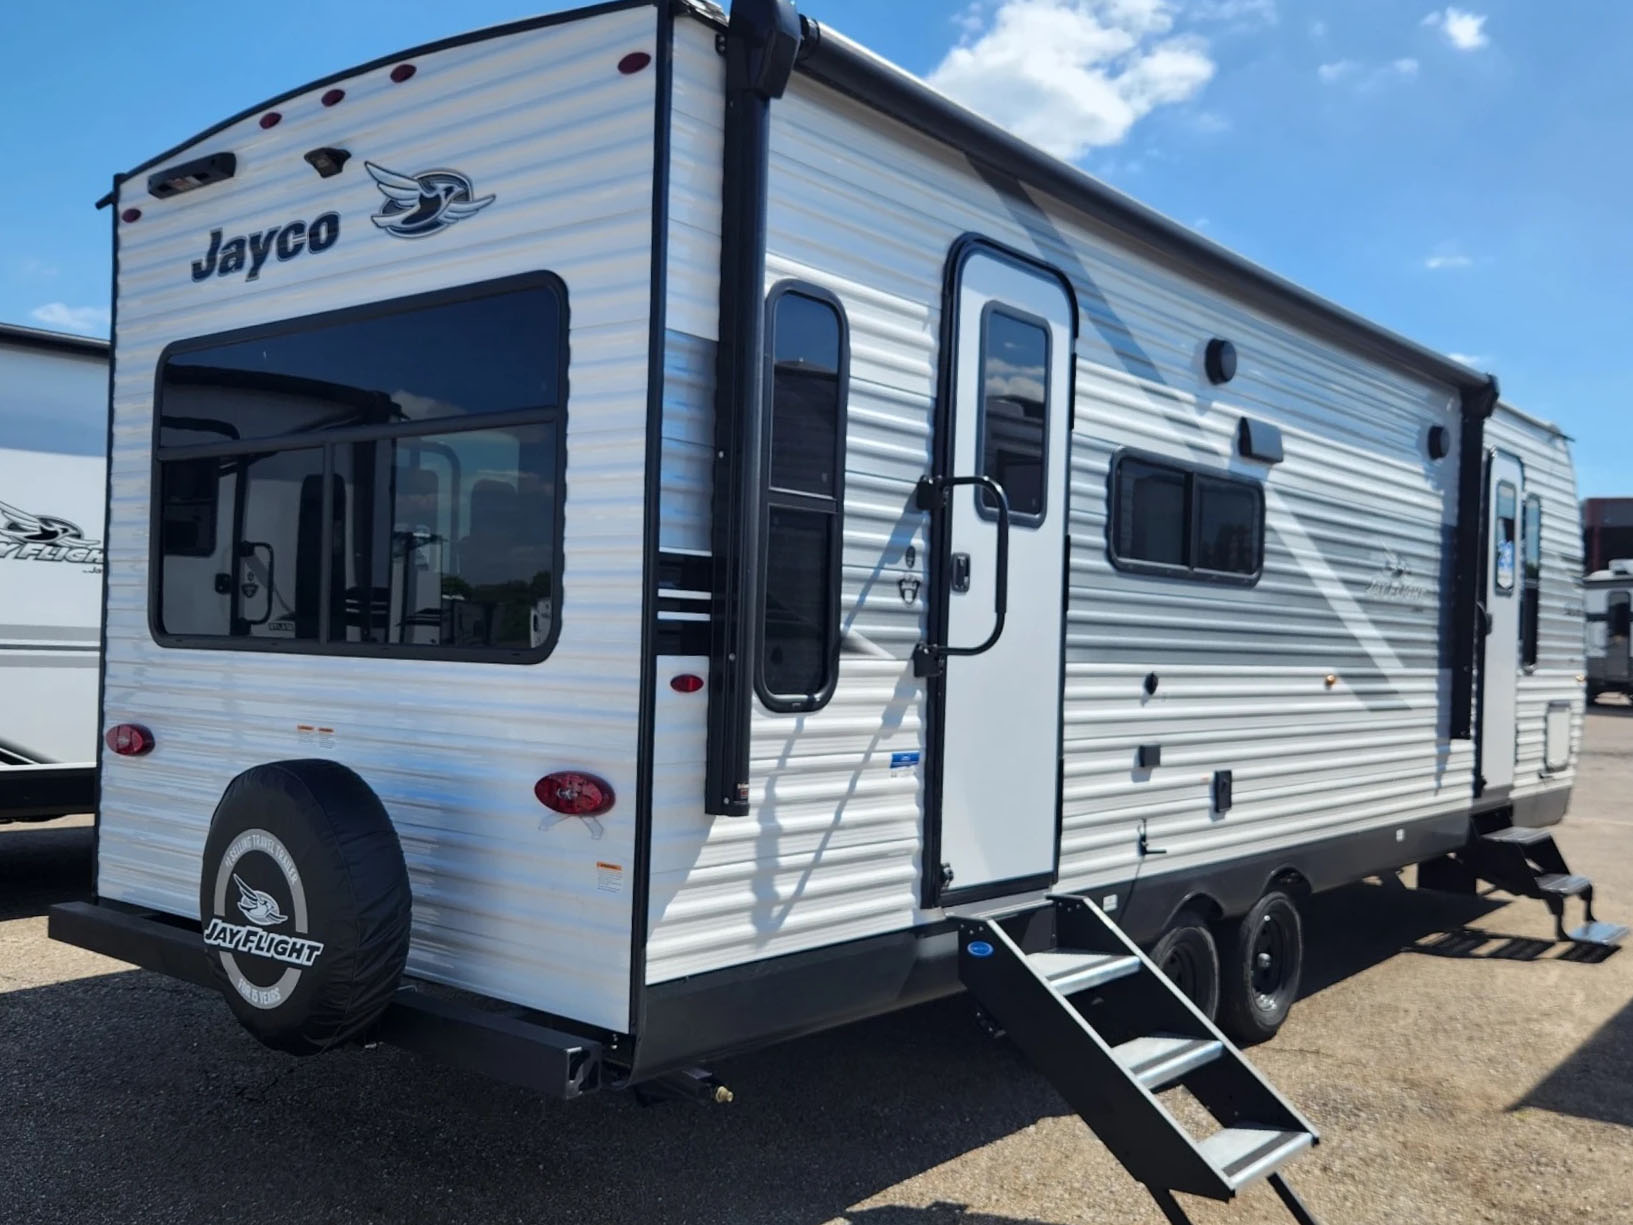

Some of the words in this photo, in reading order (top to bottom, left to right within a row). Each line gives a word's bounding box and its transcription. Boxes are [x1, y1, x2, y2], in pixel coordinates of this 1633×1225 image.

[191, 211, 341, 282] Jayco
[229, 837, 252, 862] SELLING
[252, 834, 275, 854] TRAVEL
[275, 844, 298, 885] TRAILER
